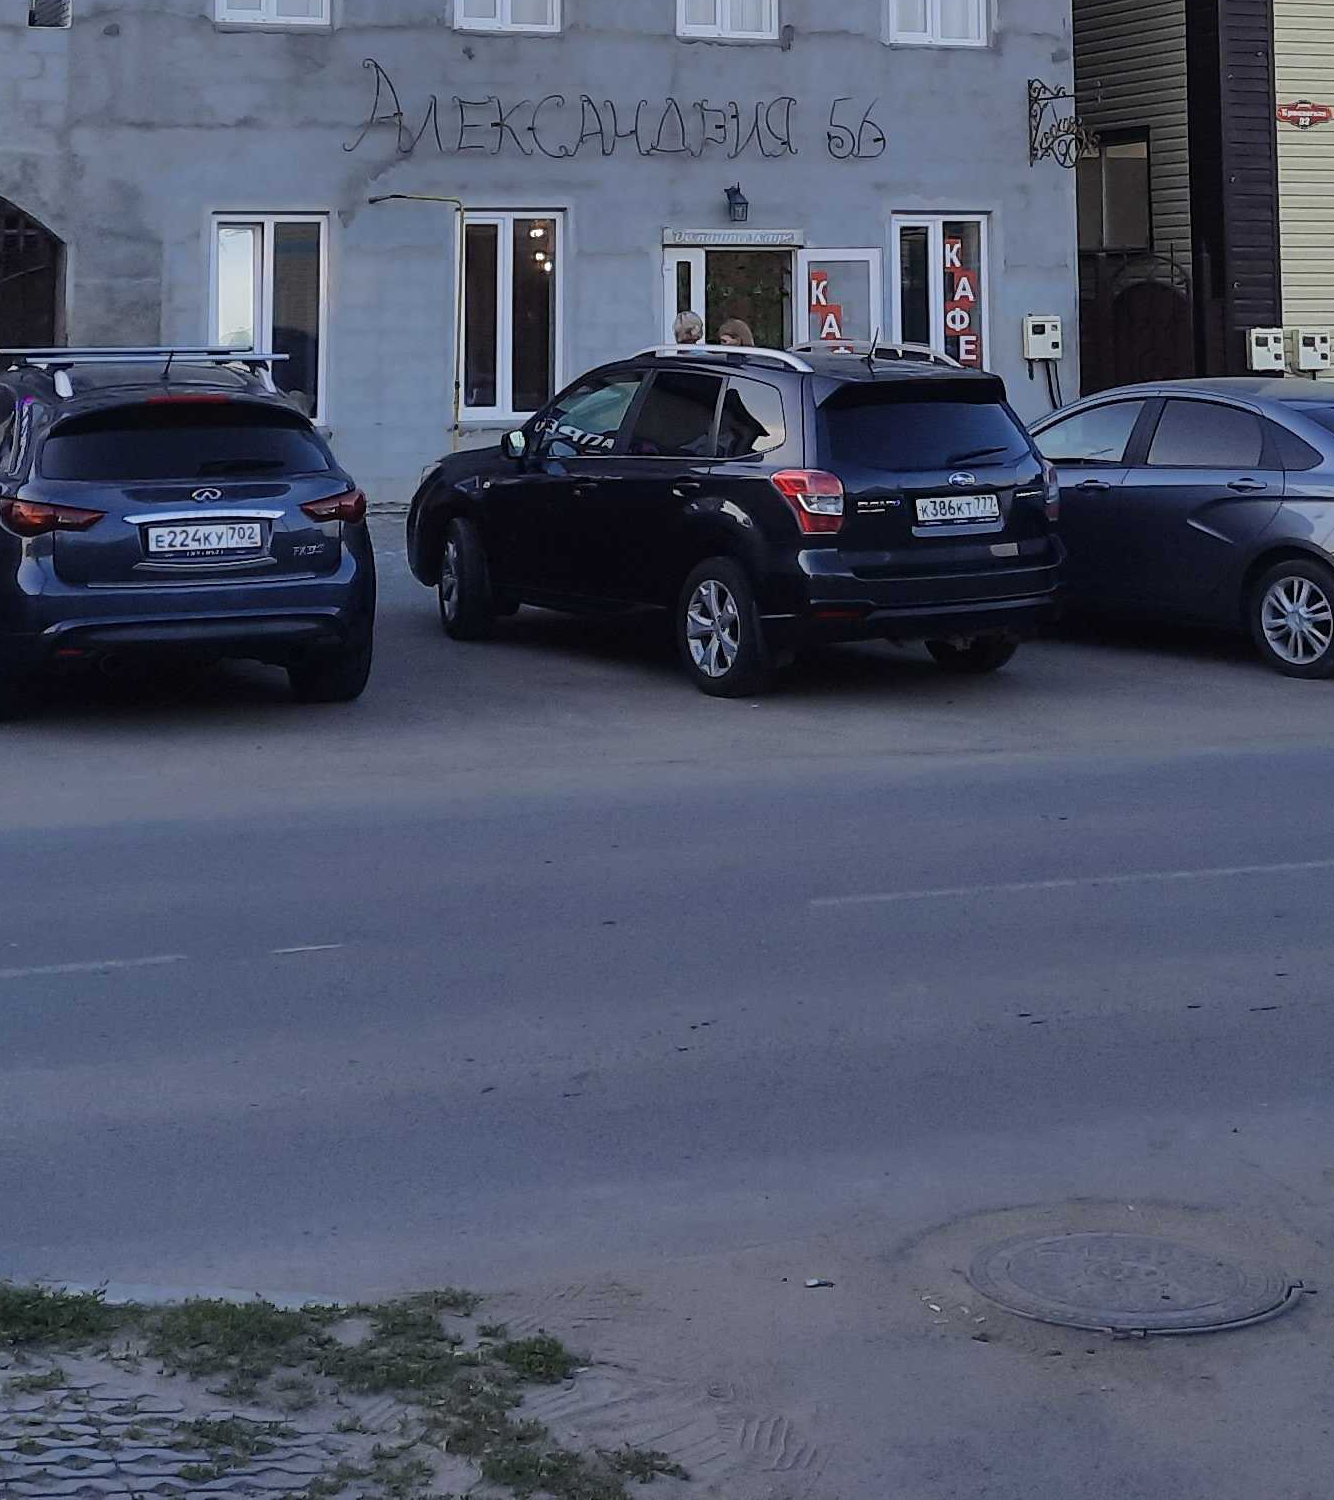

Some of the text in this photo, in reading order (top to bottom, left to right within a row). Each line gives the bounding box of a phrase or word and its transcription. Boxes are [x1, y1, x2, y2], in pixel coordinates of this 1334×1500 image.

[811, 279, 852, 354] КА
[944, 243, 977, 360] КАФЕ
[155, 528, 224, 549] Е224КУ
